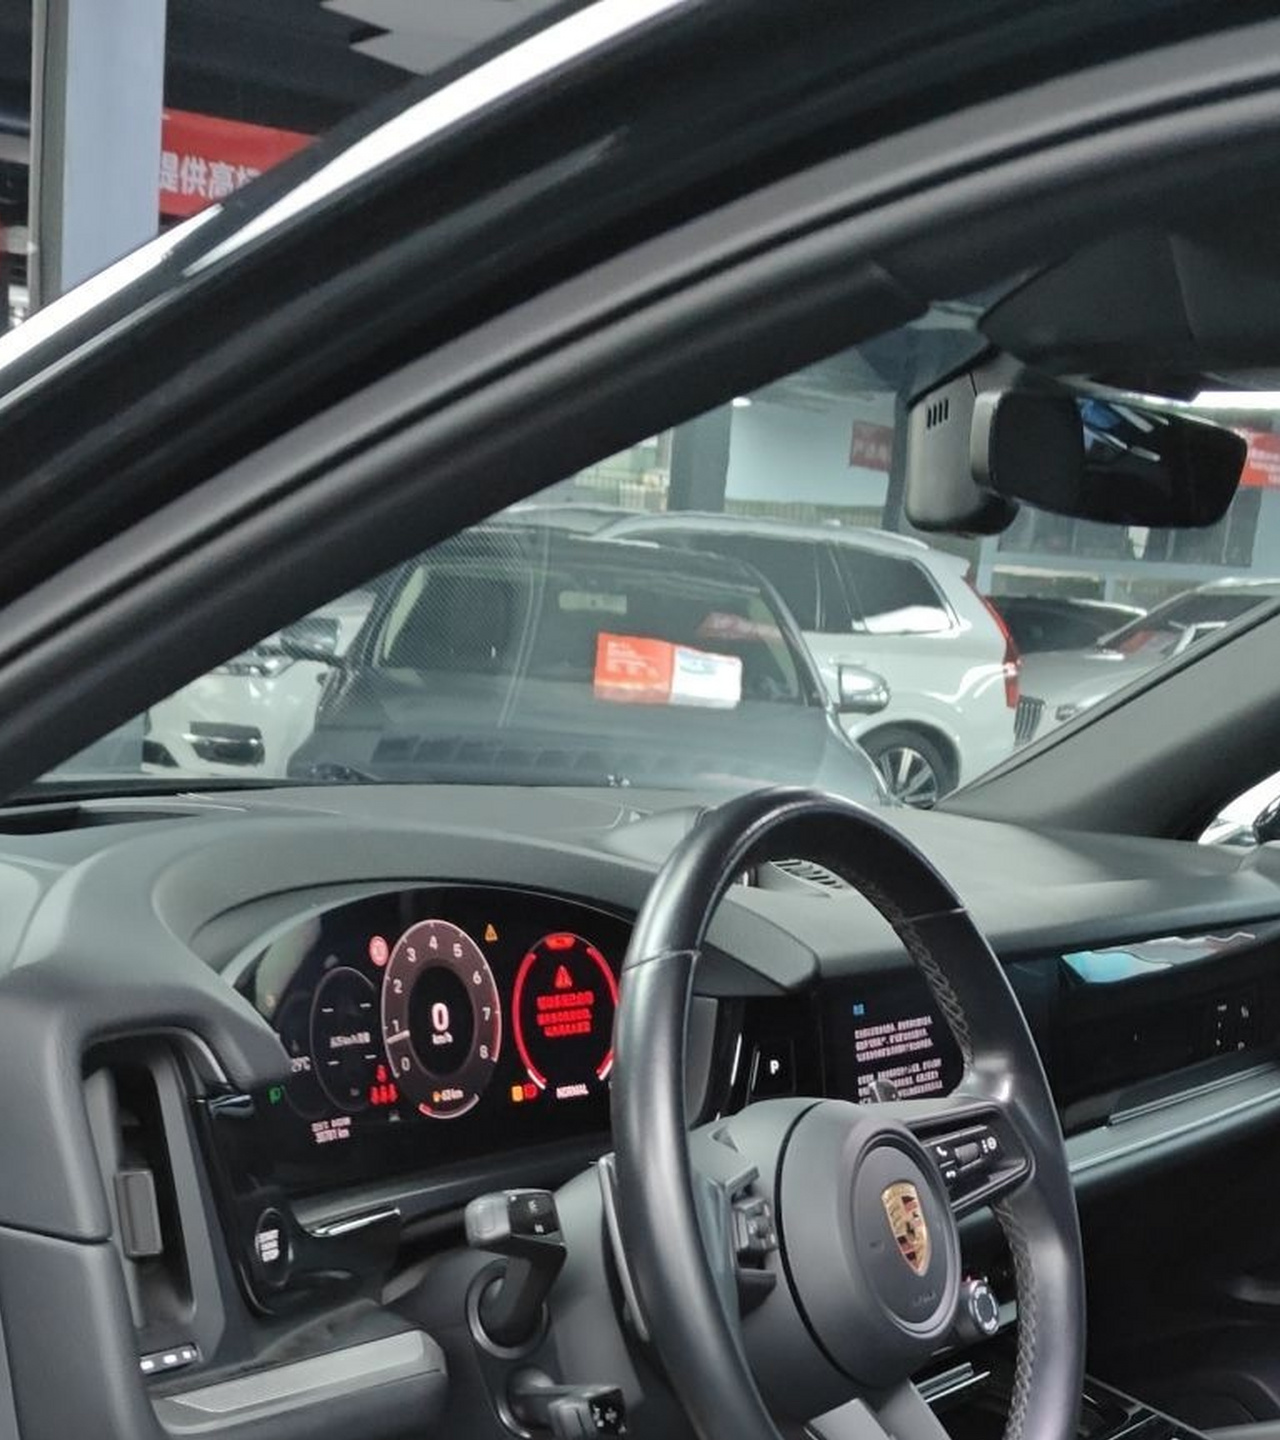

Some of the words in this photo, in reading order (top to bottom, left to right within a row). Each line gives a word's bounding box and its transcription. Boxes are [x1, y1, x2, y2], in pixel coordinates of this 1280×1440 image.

[429, 935, 438, 949] 4
[406, 948, 417, 963] 3
[453, 943, 463, 958] 5
[473, 970, 482, 985] 6
[393, 979, 403, 994] 2
[431, 1002, 450, 1032] 0
[482, 1007, 491, 1021] 7
[392, 1020, 399, 1031] 1
[479, 1045, 489, 1059] 8
[401, 1057, 411, 1072] 0
[770, 1059, 780, 1075] P
[556, 1083, 589, 1099] NORMAL
